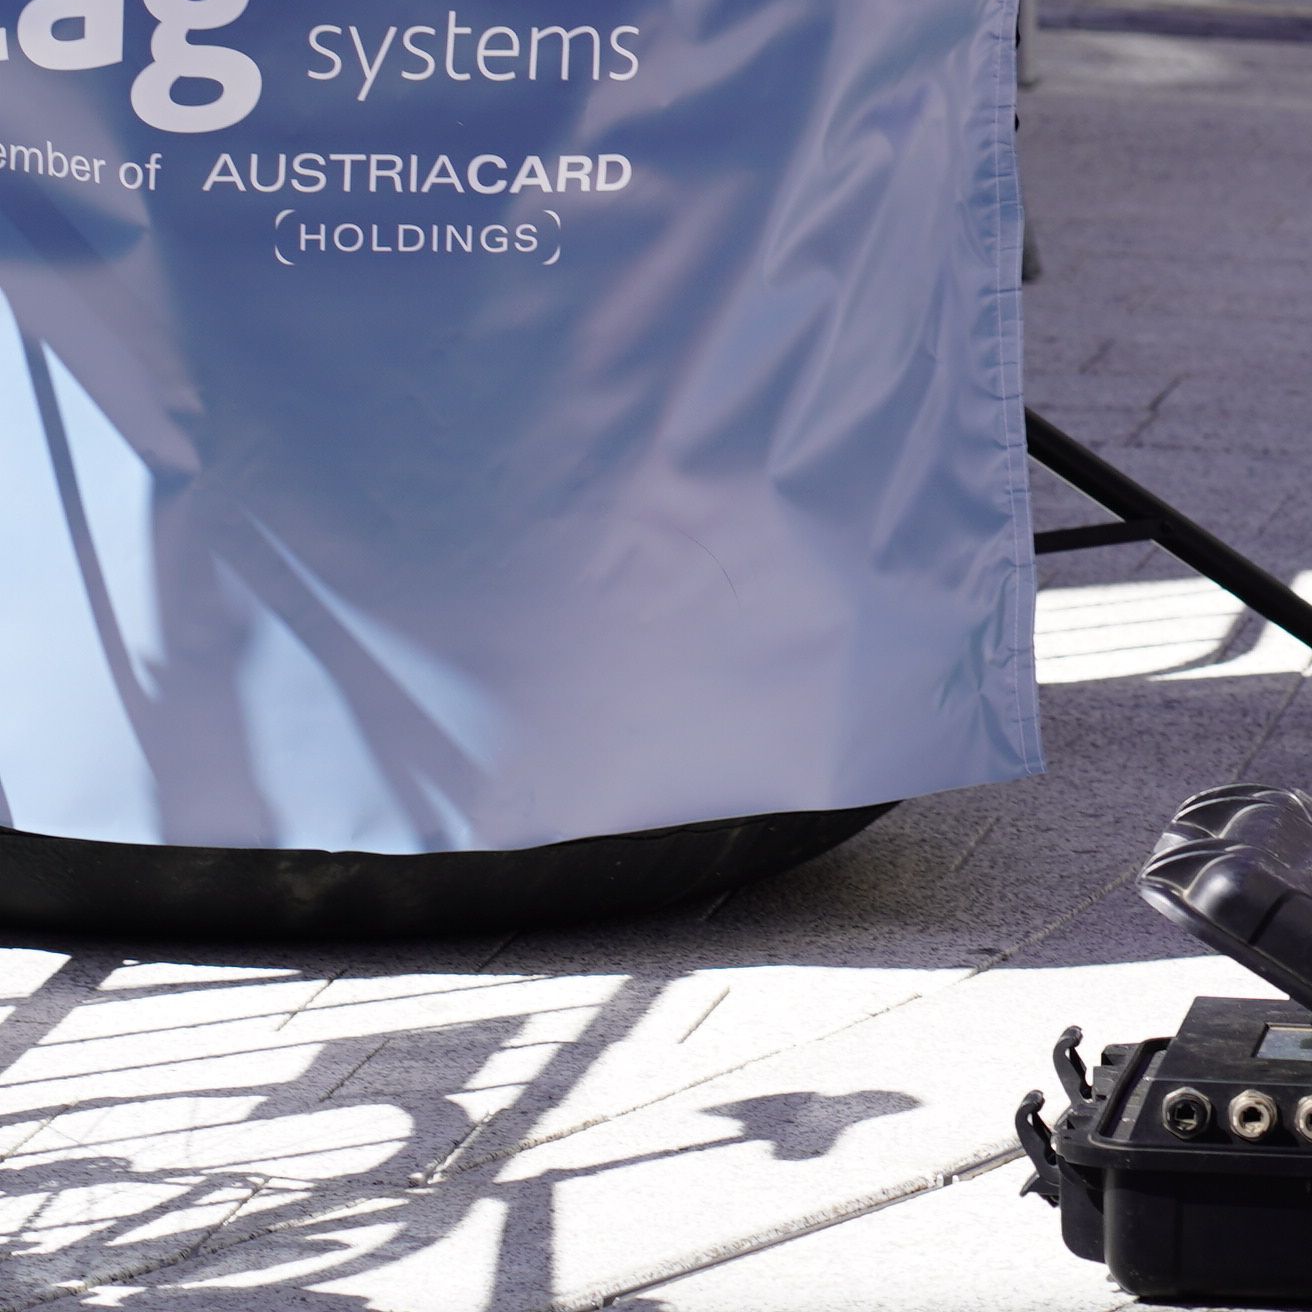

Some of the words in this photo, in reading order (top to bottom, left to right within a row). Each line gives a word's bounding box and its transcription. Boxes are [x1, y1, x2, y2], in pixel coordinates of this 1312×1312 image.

[307, 10, 640, 102] systems
[119, 153, 161, 190] of
[202, 153, 632, 194] AUSTRIACARD
